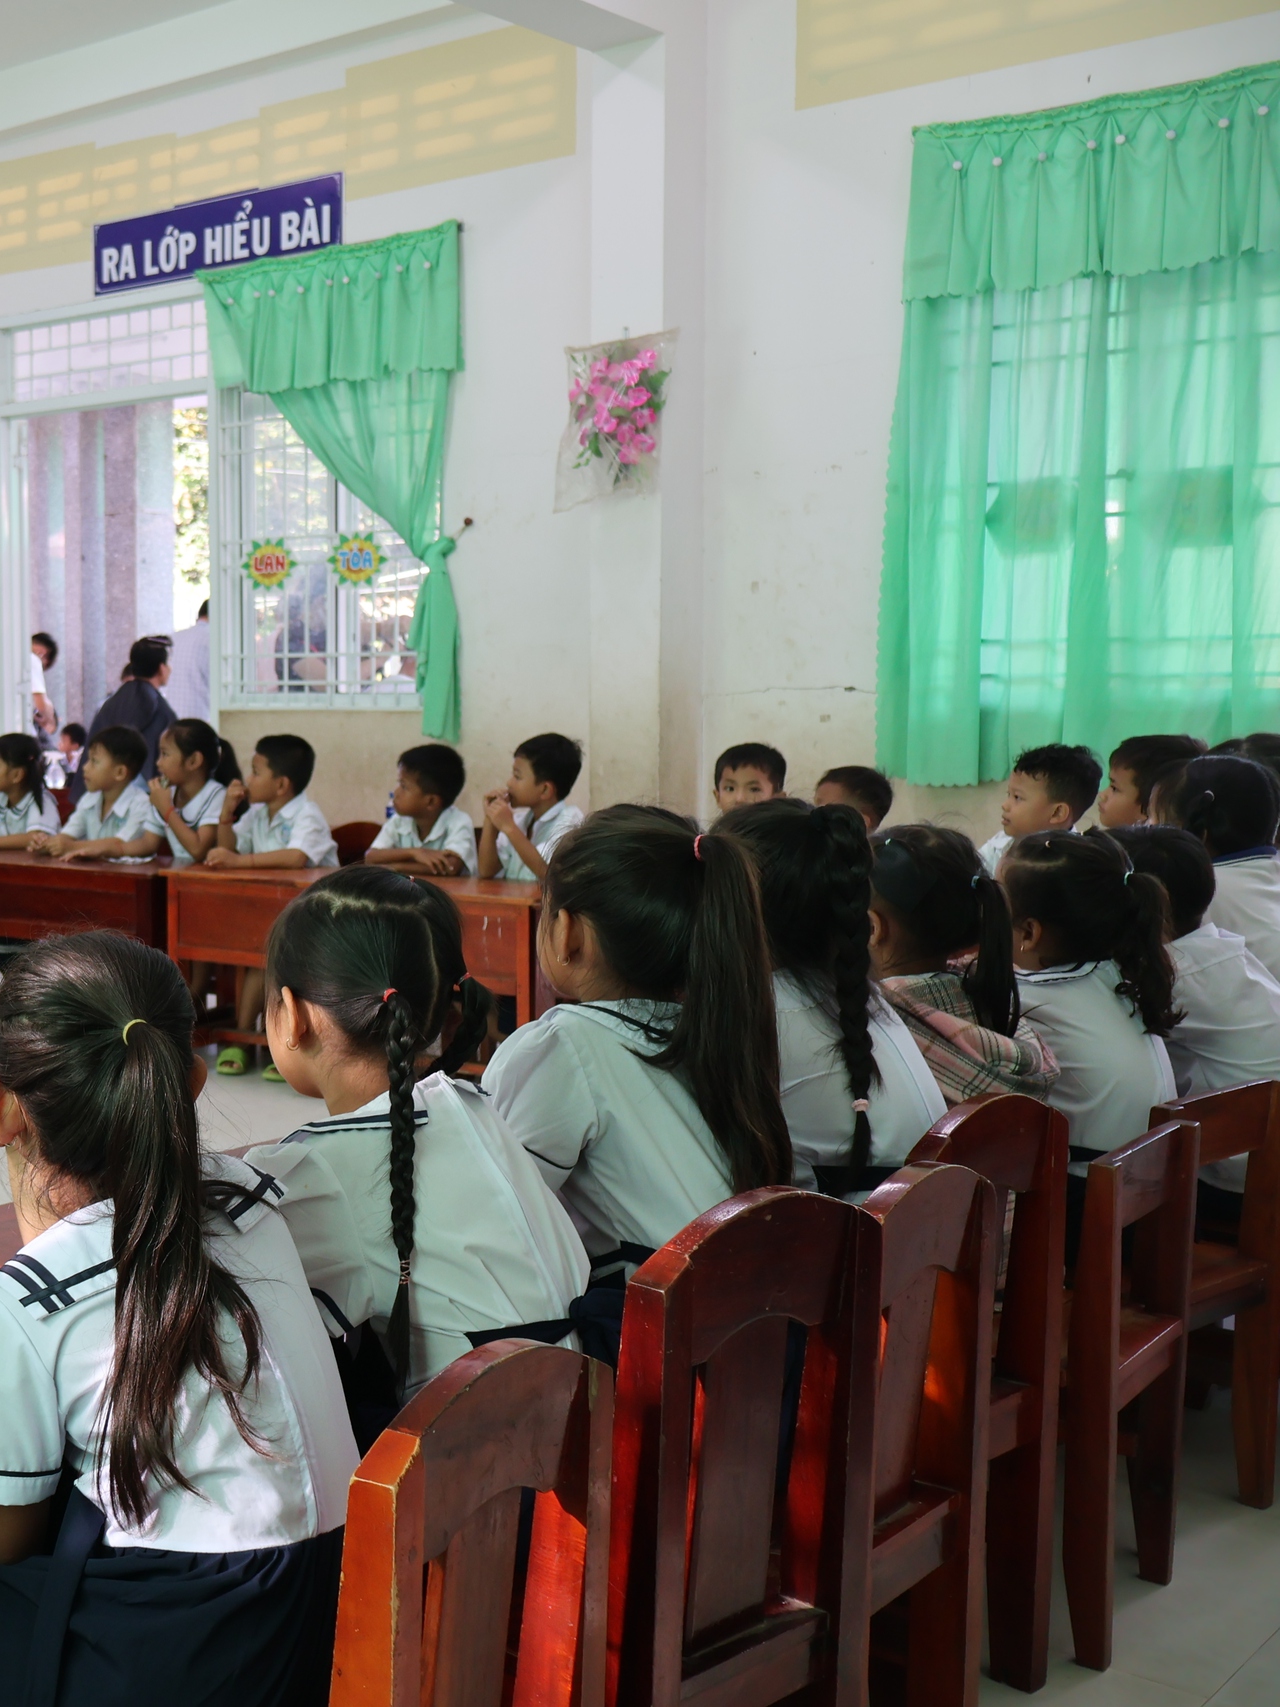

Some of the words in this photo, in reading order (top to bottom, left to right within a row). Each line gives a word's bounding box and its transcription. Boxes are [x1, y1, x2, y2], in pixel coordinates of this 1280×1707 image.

[101, 244, 136, 284] RA
[143, 225, 197, 276] LỚP
[204, 200, 270, 266] HIỂU
[280, 197, 331, 251] BÀI
[253, 553, 286, 574] LAN
